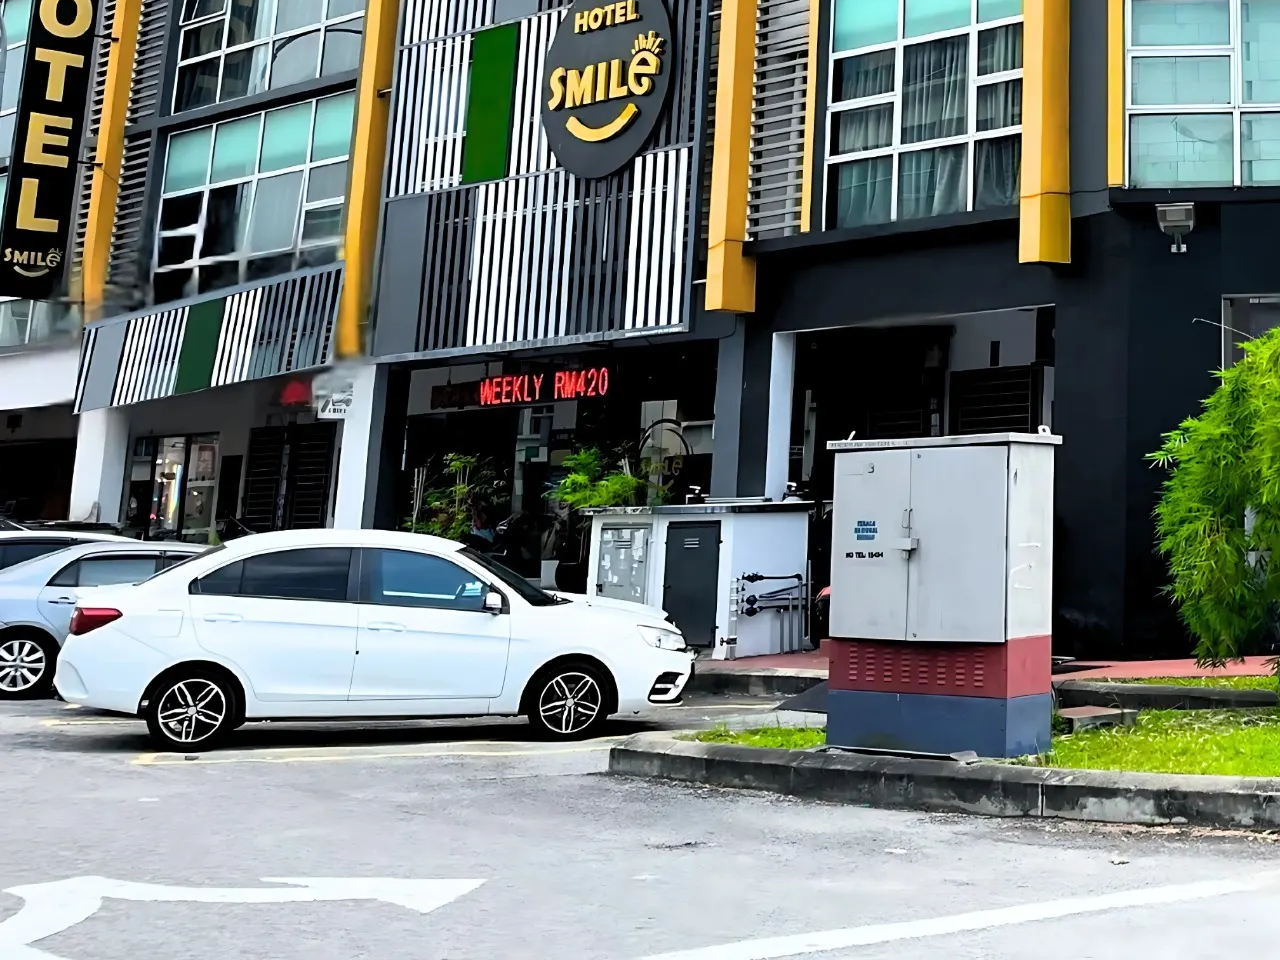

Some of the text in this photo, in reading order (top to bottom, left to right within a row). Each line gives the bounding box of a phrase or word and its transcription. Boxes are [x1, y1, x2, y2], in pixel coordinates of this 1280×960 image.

[574, 0, 640, 34] HOTEL
[480, 367, 609, 406] WEEKLY RM420
